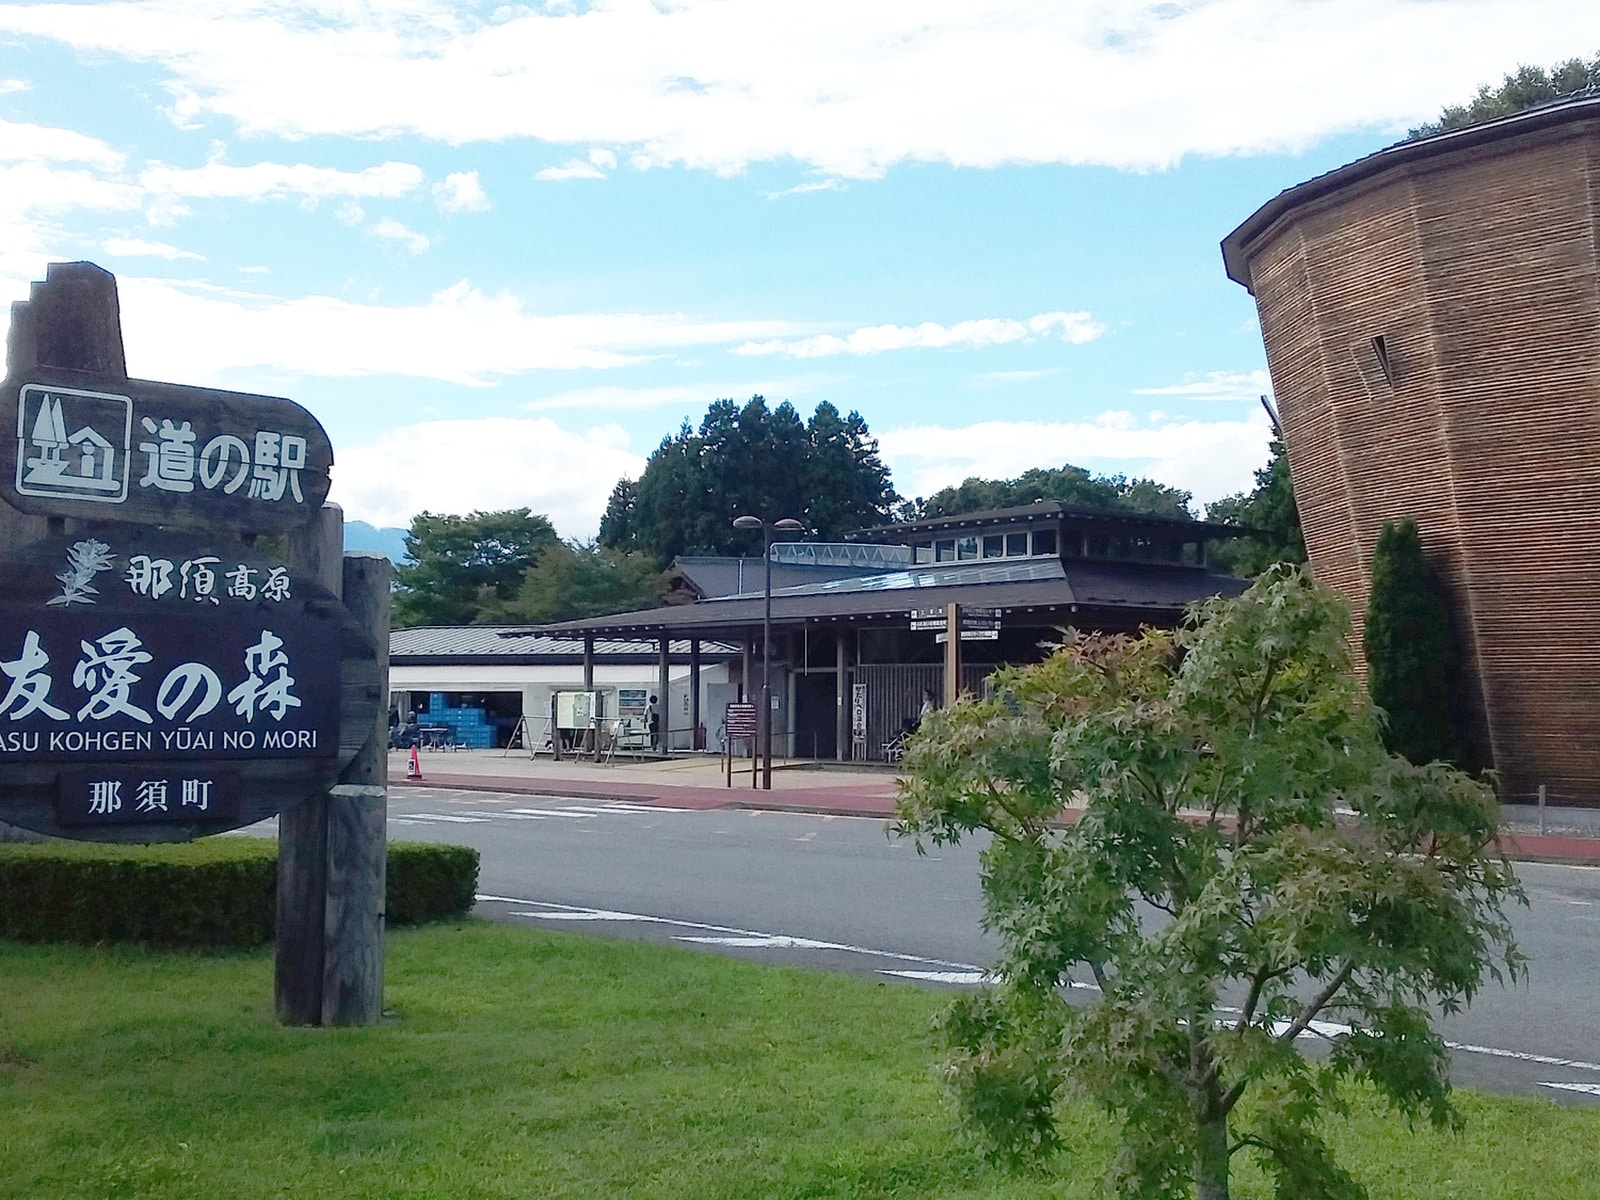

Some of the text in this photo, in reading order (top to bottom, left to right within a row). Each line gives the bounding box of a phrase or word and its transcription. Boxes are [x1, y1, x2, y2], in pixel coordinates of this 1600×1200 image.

[139, 416, 307, 503] 道の駅
[0, 626, 302, 724] 友愛の森
[50, 731, 151, 751] KOHGEN
[223, 731, 255, 749] NO
[262, 729, 317, 749] MORI
[88, 779, 213, 814] 那須町
